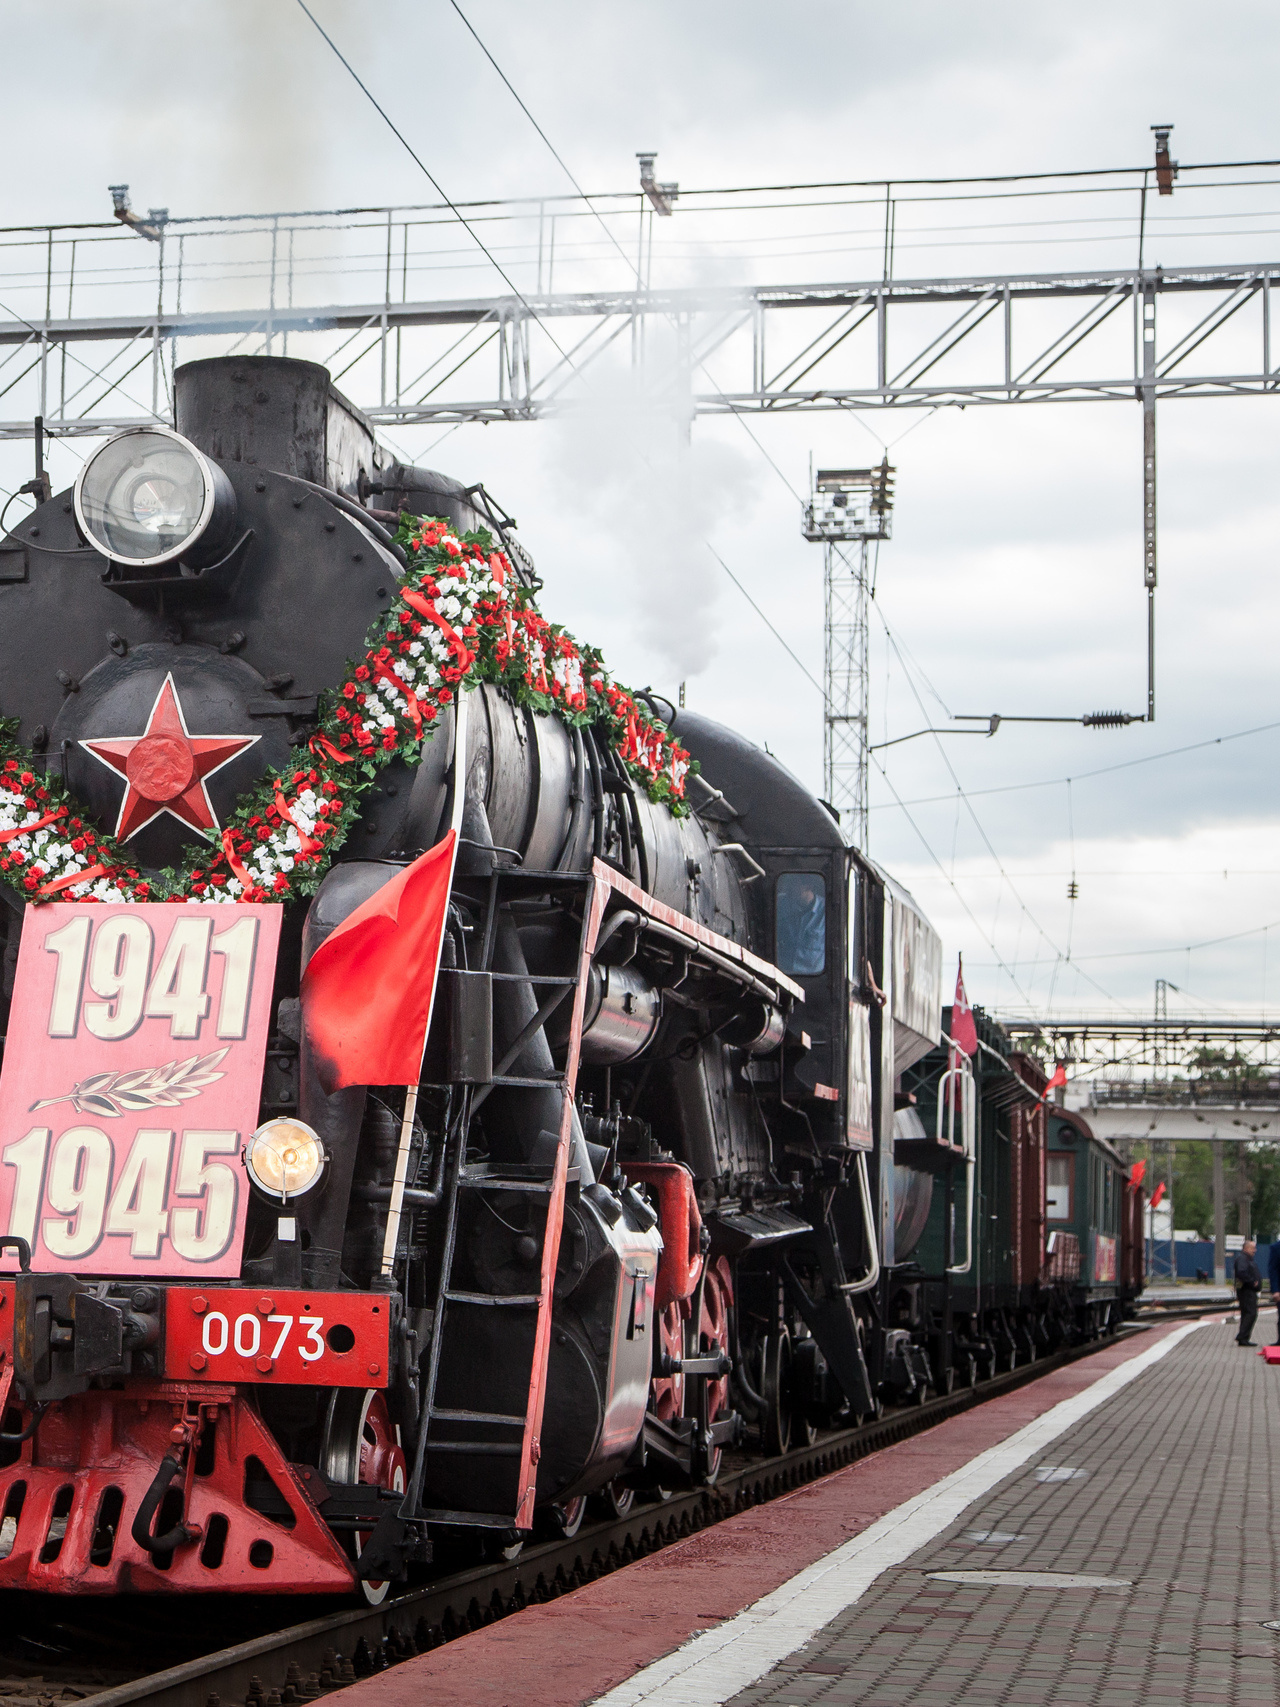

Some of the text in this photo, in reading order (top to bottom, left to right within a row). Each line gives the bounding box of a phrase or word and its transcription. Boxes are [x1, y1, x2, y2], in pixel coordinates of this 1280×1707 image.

[42, 914, 259, 1041] 1941
[1, 1124, 240, 1263] 1945
[202, 1311, 327, 1362] 0073
